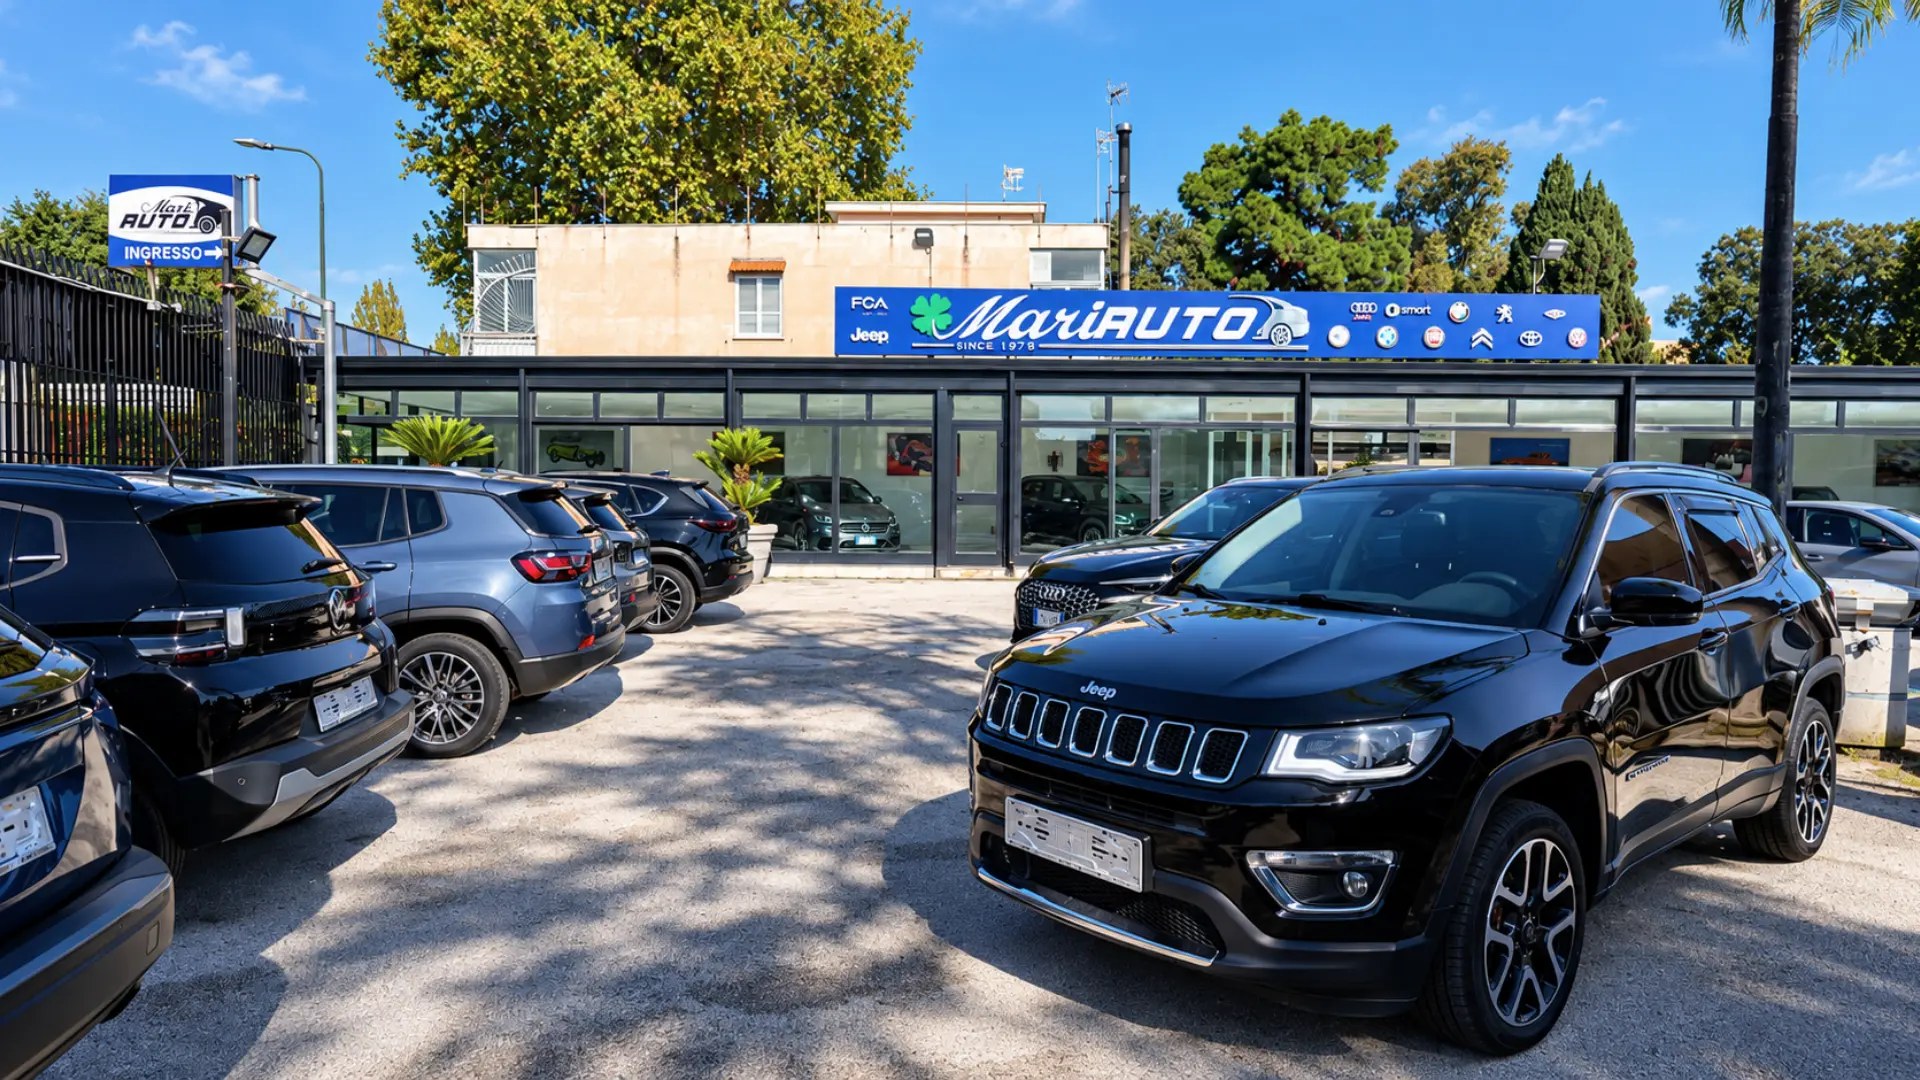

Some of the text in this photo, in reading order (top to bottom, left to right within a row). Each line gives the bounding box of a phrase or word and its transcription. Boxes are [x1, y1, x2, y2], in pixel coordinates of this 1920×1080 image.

[119, 213, 191, 229] AUTO
[124, 246, 202, 260] INGRESSO
[851, 296, 889, 310] FCA
[1401, 304, 1431, 315] smart
[850, 327, 889, 344] Jeep
[956, 341, 994, 351] SINCE
[1080, 680, 1117, 701] Jeep
